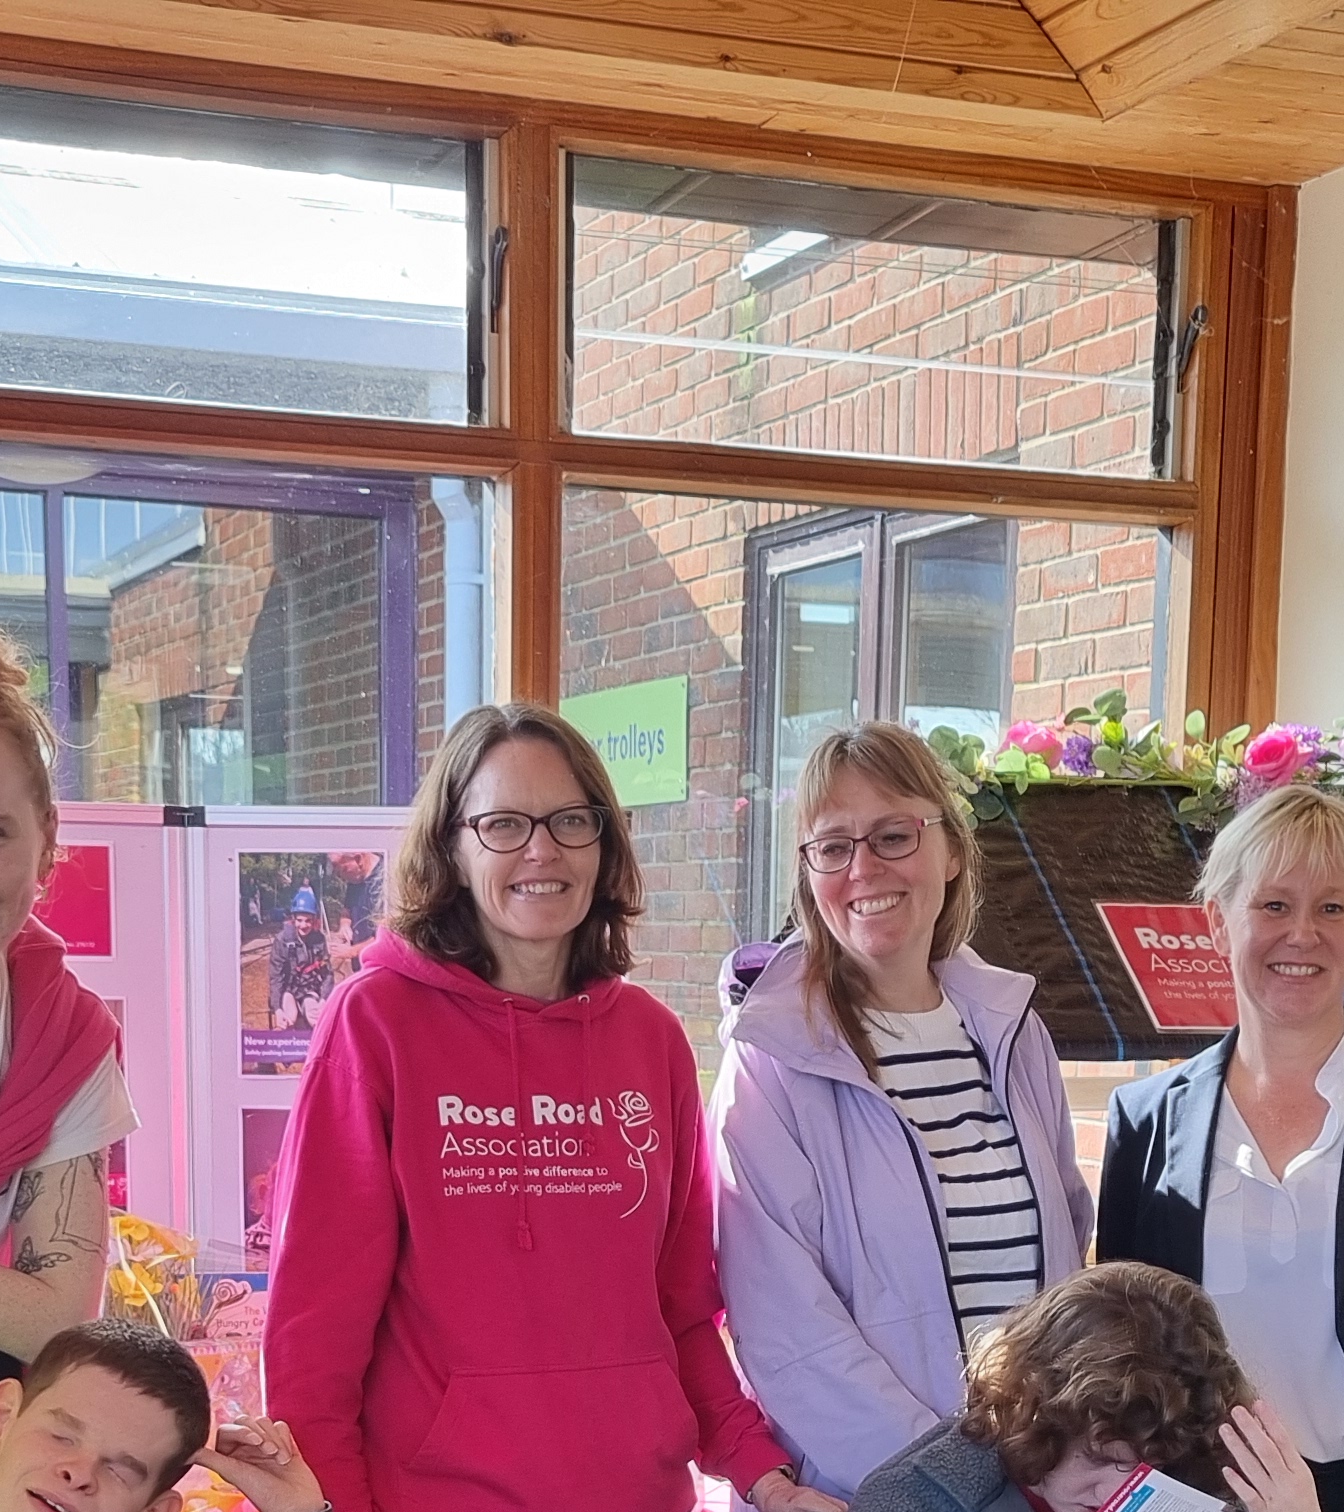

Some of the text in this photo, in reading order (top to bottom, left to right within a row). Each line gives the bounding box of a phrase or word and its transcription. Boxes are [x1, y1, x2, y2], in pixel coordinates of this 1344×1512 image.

[608, 723, 665, 765] trolleys
[1134, 927, 1213, 950] Rose
[1151, 953, 1233, 973] Associ
[1158, 978, 1196, 989] Making
[1207, 979, 1234, 989] posit
[1164, 991, 1182, 999] the
[1186, 991, 1206, 999] lives
[1210, 991, 1219, 999] of
[244, 1036, 311, 1048] New experienc
[438, 1095, 603, 1126] Rose Road
[443, 1165, 485, 1179] Making
[499, 1167, 540, 1179] posive
[543, 1166, 593, 1177] difference
[596, 1167, 608, 1176] to
[444, 1185, 463, 1196] the
[467, 1182, 492, 1194] lives
[495, 1181, 508, 1192] of
[545, 1182, 585, 1194] disabled
[588, 1181, 623, 1194] people
[245, 1306, 260, 1315] The
[216, 1319, 249, 1329] Hungry
